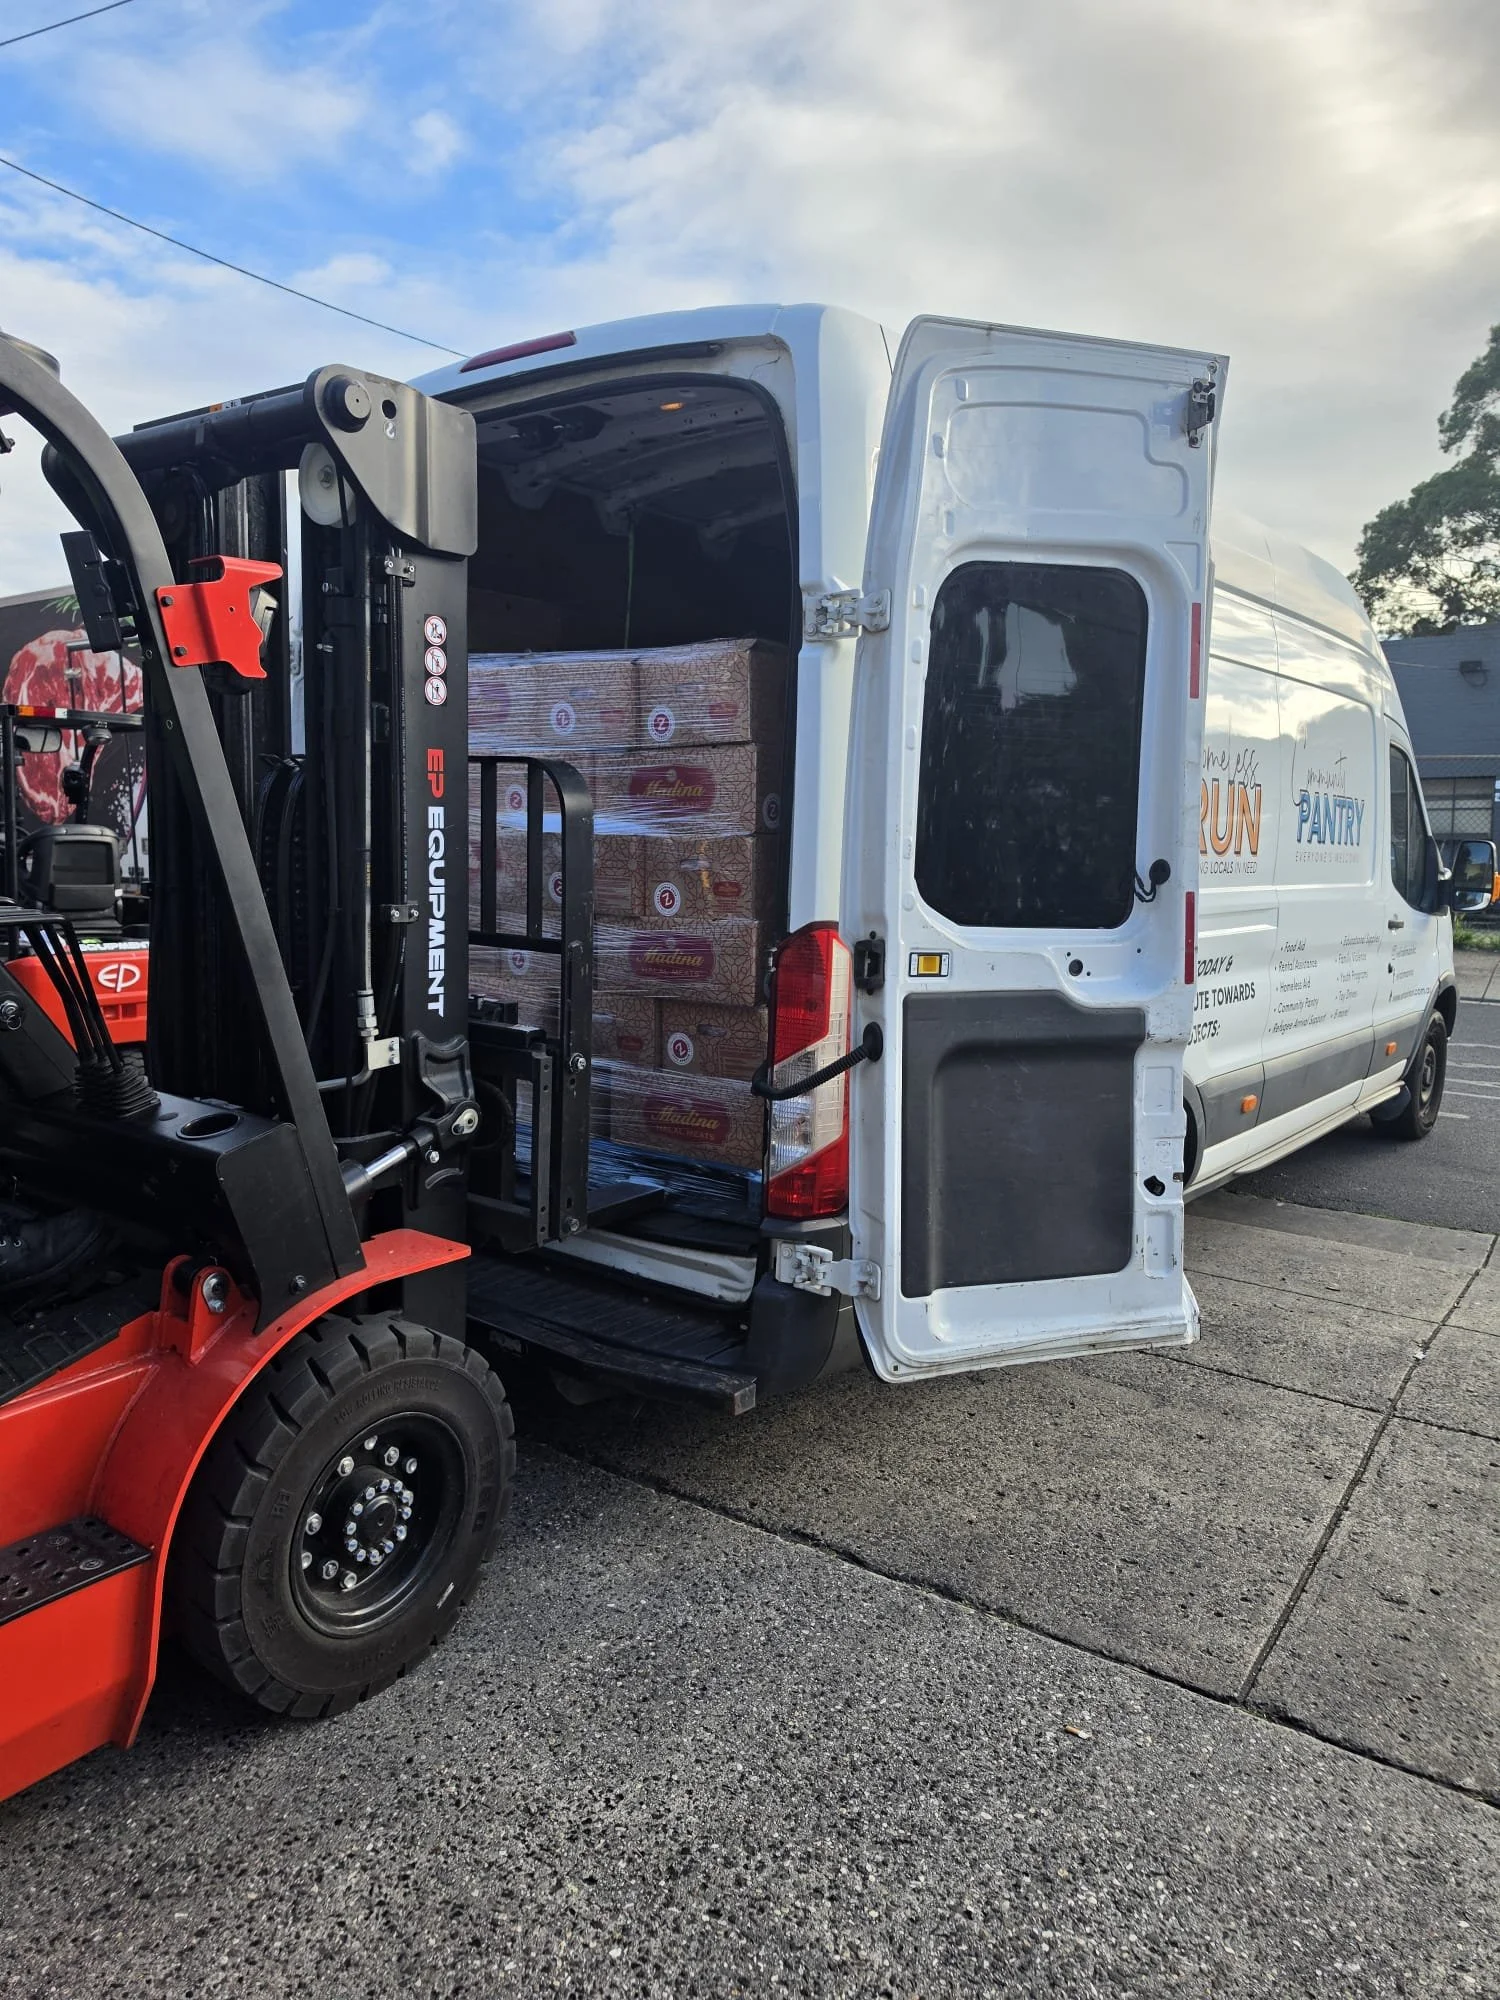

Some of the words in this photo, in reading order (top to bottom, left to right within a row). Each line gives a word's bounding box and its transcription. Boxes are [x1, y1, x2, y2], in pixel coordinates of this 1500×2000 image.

[427, 748, 445, 799] EP
[1296, 789, 1366, 847] PANTRY
[1210, 860, 1234, 874] LOCALS
[1243, 860, 1258, 874] NEED
[427, 805, 446, 1018] EQUIPMENT
[97, 962, 141, 993] EP
[1212, 981, 1256, 1008] TOWARDS
[651, 1105, 720, 1130] Madina
